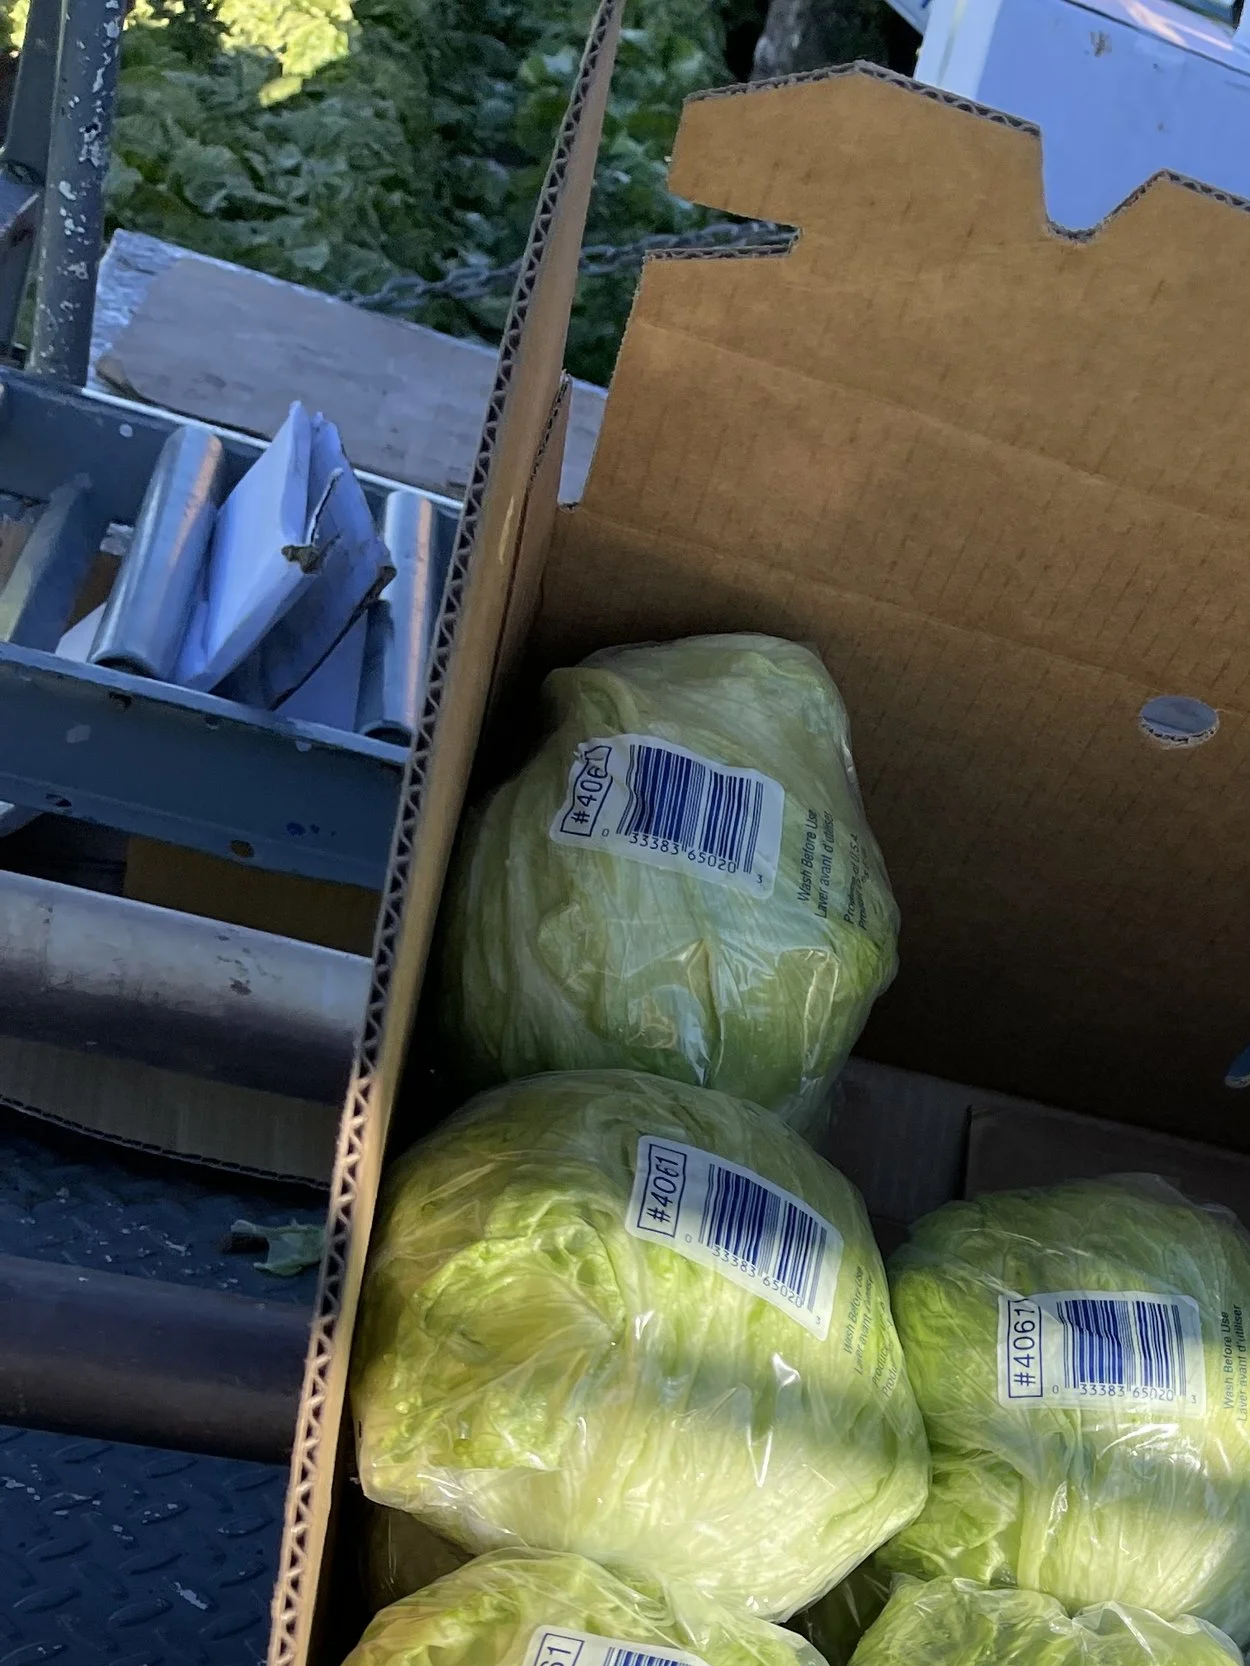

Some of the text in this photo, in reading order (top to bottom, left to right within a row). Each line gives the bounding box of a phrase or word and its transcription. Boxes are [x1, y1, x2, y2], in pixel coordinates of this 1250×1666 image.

[601, 829, 764, 884] 0 33383 65020 3
[797, 809, 818, 901] Wash Before Use
[820, 854, 832, 887] avant
[815, 887, 829, 918] Laver
[646, 1154, 680, 1223] #4061
[685, 1233, 821, 1325] 0 33383 65020 3
[882, 1366, 897, 1398] Produ
[1012, 1308, 1036, 1387] #4061
[1221, 1311, 1234, 1409] Wash Before Use
[1233, 1304, 1247, 1421] Laver avant d'utiliser
[1052, 1384, 1197, 1404] 0 33383 65020 3
